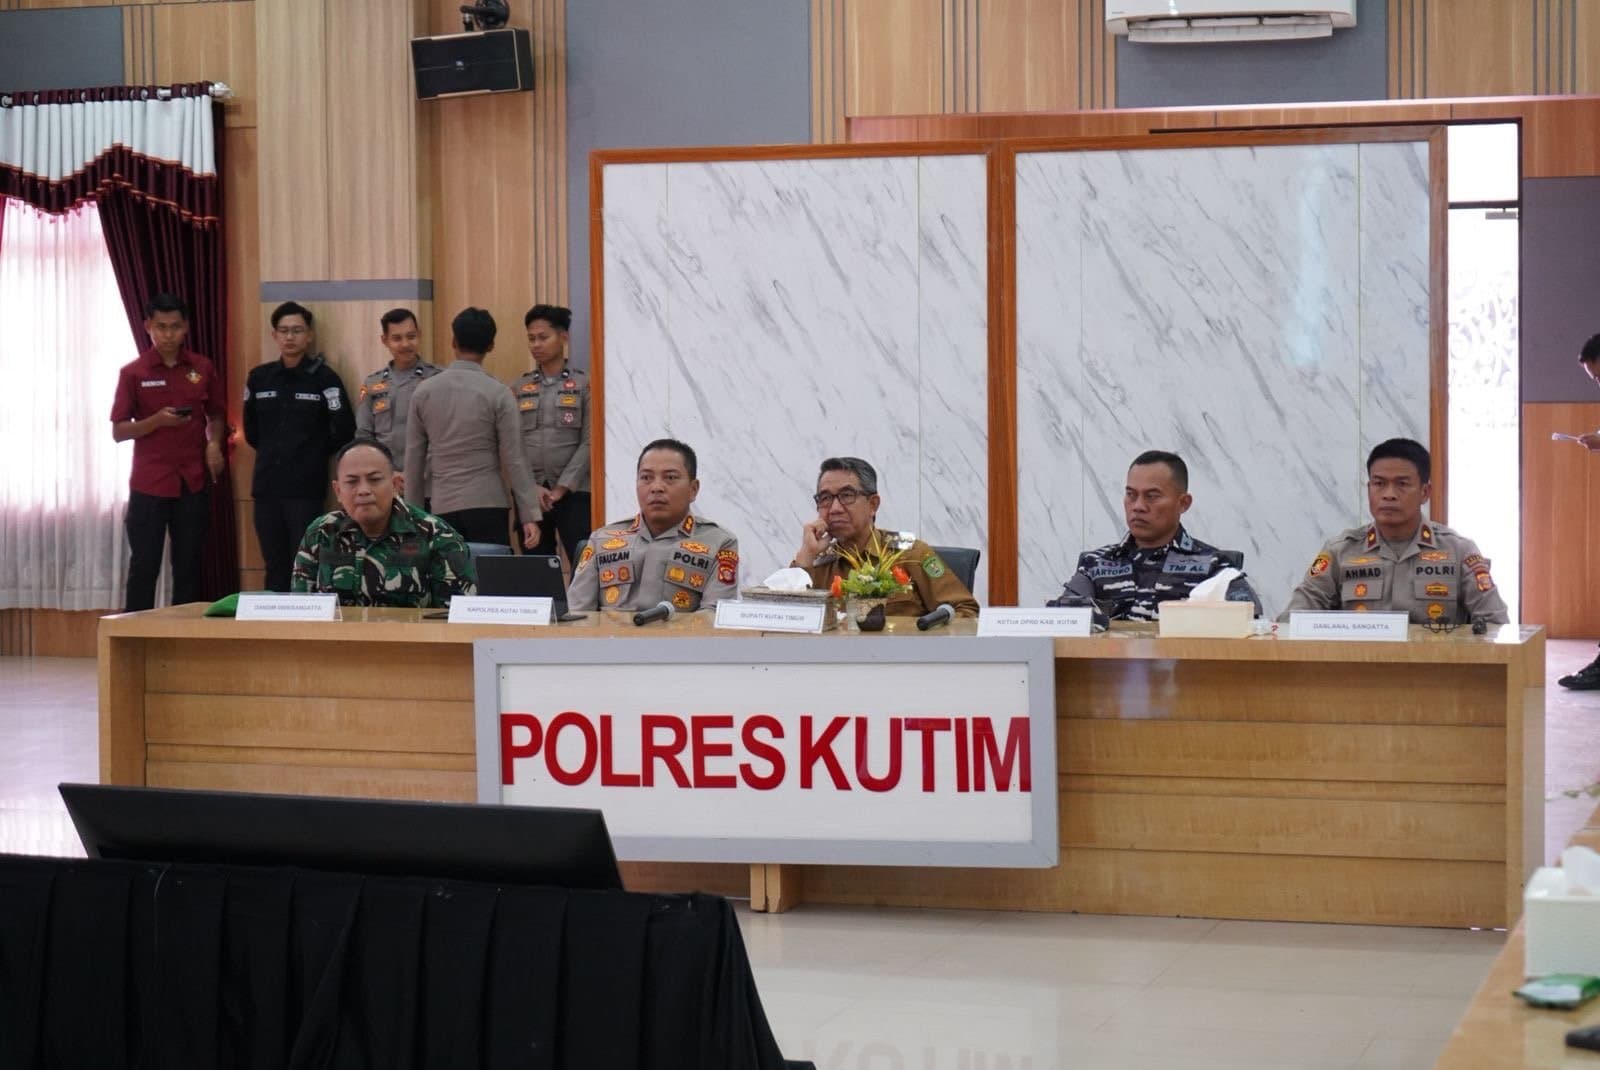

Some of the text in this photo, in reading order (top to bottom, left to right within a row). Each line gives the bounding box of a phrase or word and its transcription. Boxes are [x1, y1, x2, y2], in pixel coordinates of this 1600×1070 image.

[599, 551, 630, 565] FAUZAN
[673, 551, 710, 569] POLRI
[1169, 564, 1204, 572] TNI AL
[1344, 567, 1382, 579] AHMAD
[1415, 565, 1455, 576] POLRI
[500, 711, 1032, 793] POLRES KUTIM
